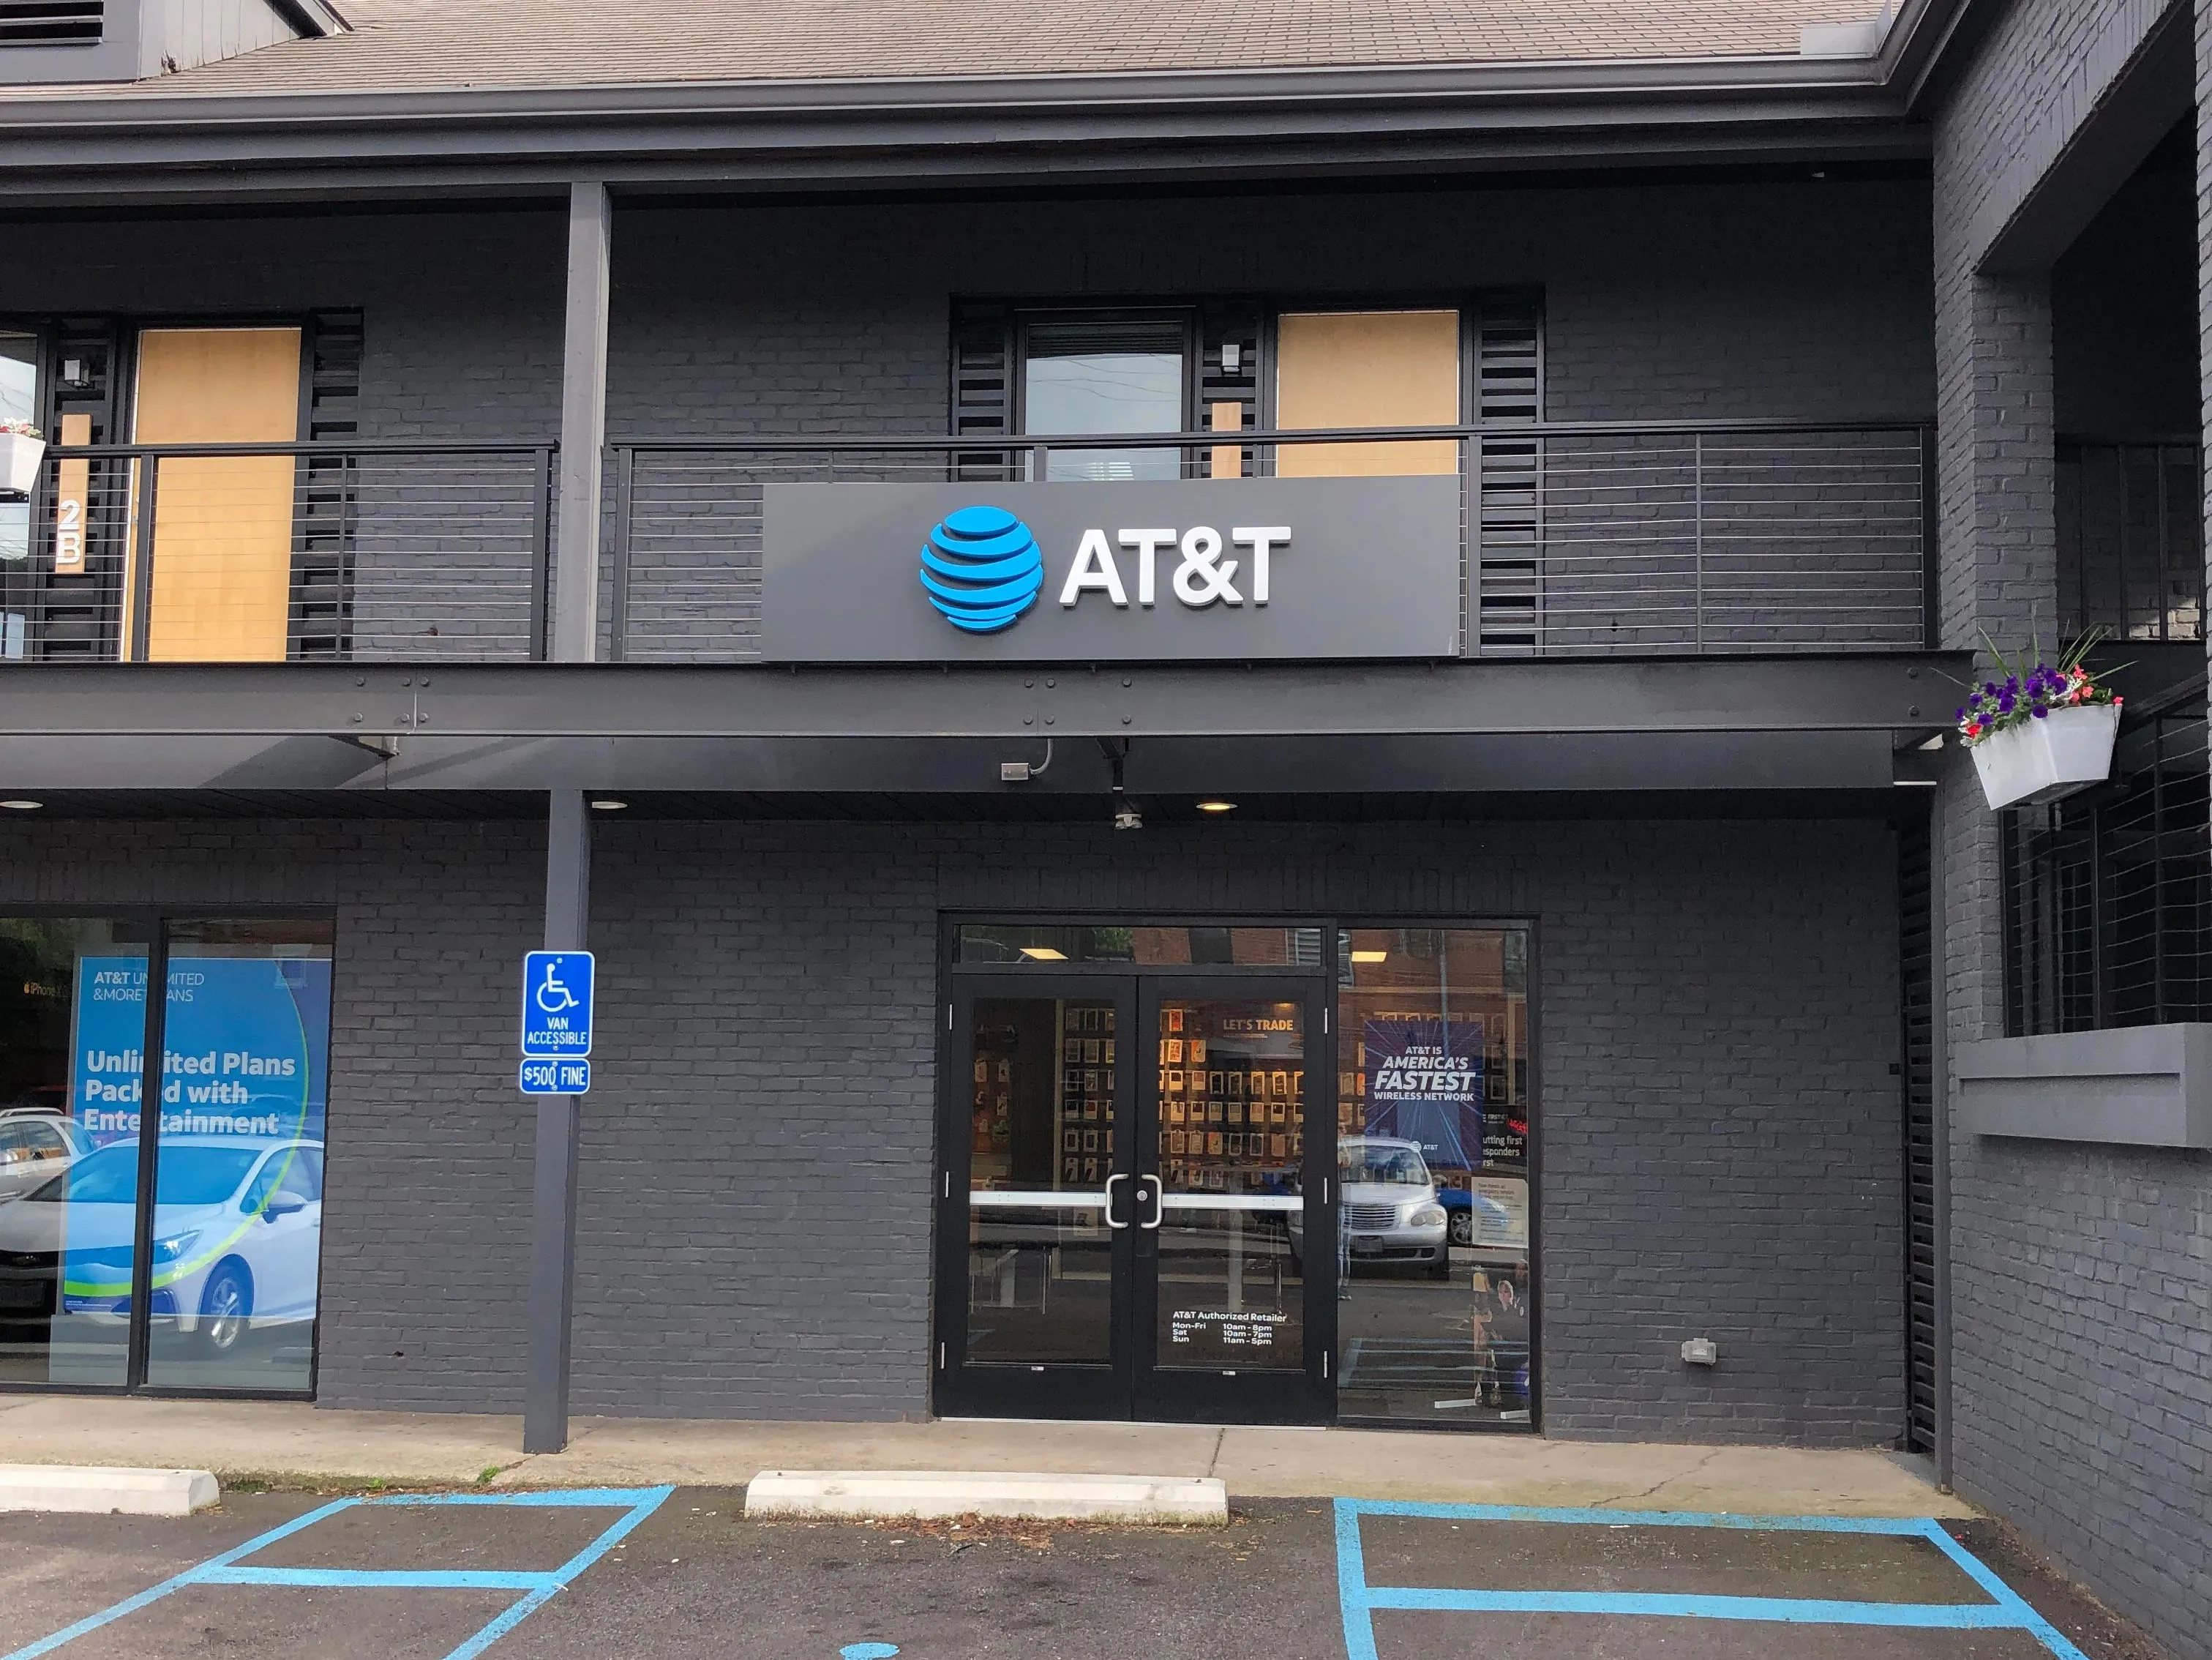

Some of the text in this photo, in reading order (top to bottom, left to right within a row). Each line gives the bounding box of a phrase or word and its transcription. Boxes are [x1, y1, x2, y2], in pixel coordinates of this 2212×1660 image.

[1060, 526, 1291, 607] AT&T
[94, 971, 131, 984] AT&T
[547, 1017, 569, 1030] VAN
[1223, 1019, 1294, 1031] LET'S TRADE
[527, 1031, 587, 1045] ACCESSIBLE
[1405, 1046, 1442, 1055] AT&T IS
[87, 1049, 296, 1076] Unliited Plans
[1382, 1055, 1469, 1070] AMERICA'S
[524, 1066, 586, 1086] $500 FINE
[1374, 1070, 1476, 1091] FASTEST
[85, 1078, 248, 1104] Packd with
[1373, 1091, 1474, 1102] WIRELESS NETWORK
[83, 1108, 280, 1134] Entetainment
[1482, 1134, 1523, 1146] utting first
[1172, 1311, 1286, 1323] AT&T Authorized Retailer
[1252, 1324, 1272, 1332] 8pm
[1253, 1331, 1272, 1339] 7pm
[1251, 1338, 1272, 1346] 5pm
